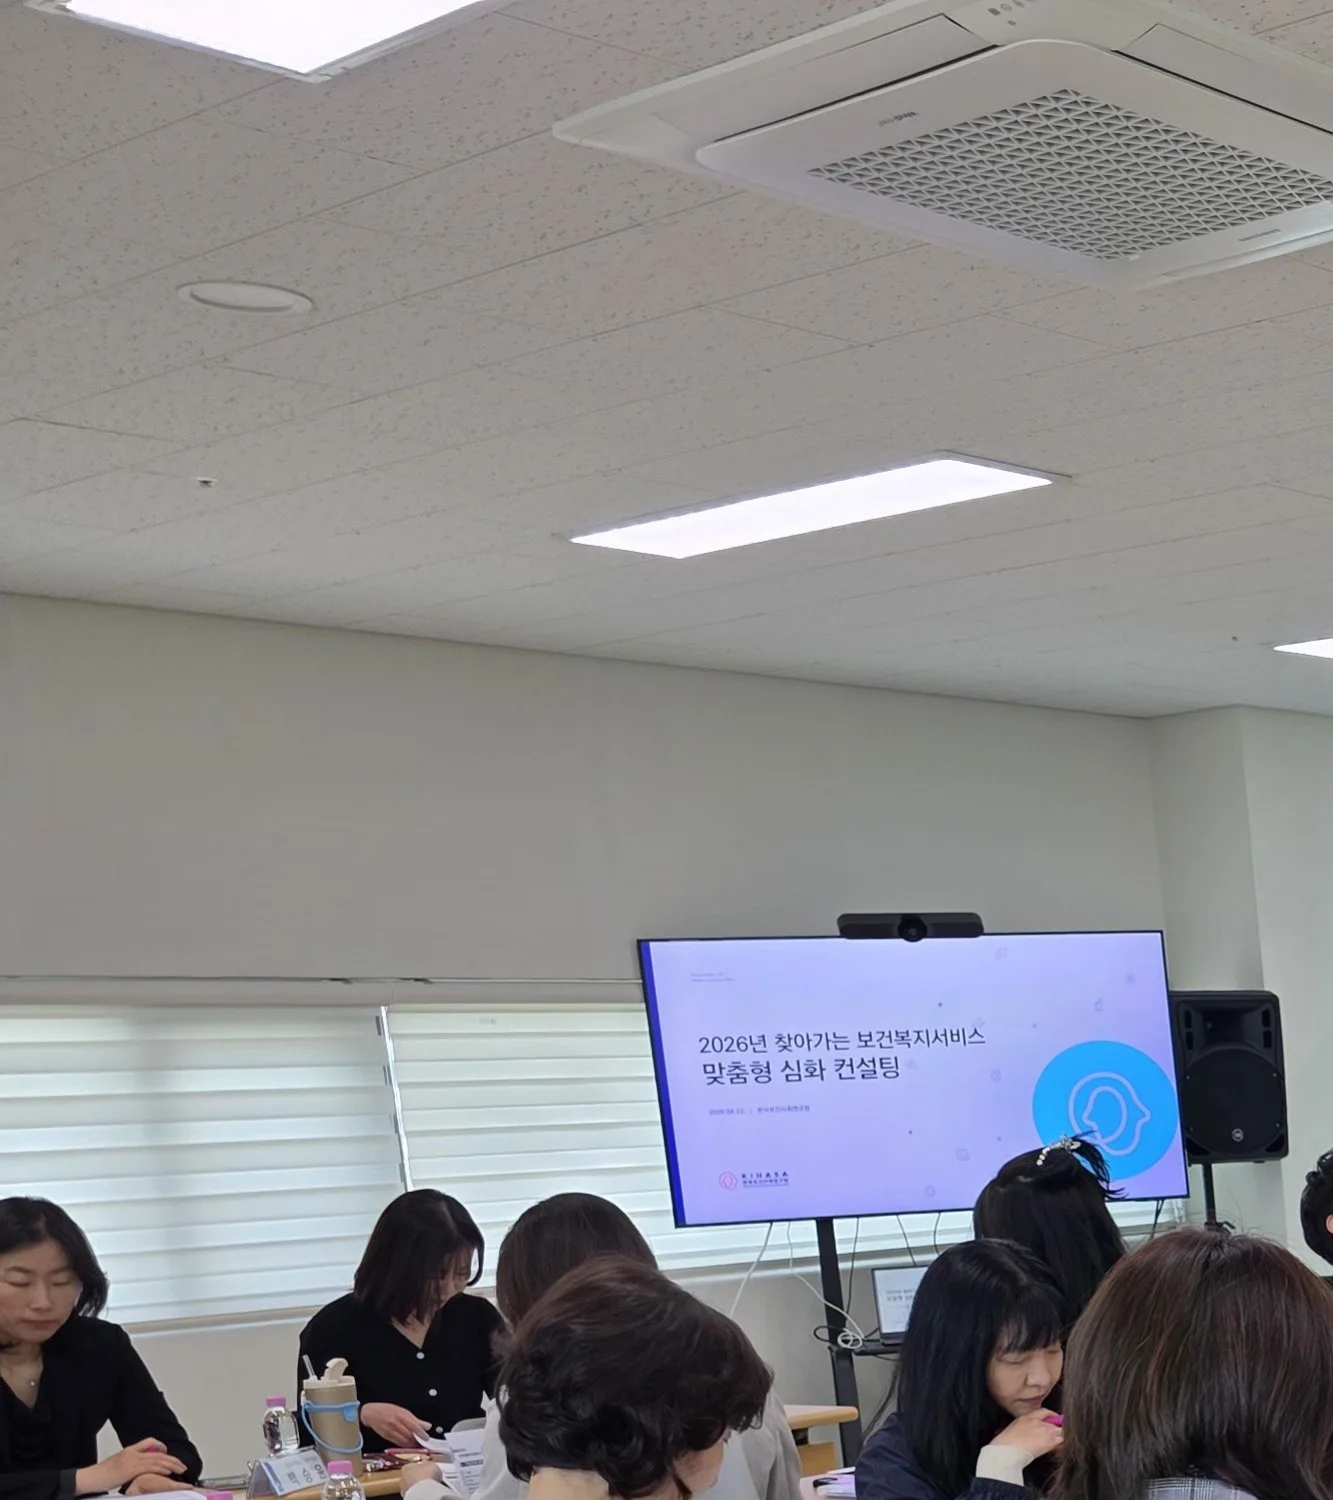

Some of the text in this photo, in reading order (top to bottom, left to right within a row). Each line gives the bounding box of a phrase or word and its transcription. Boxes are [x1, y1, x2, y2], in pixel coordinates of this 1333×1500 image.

[699, 1025, 986, 1054] 2026년 찾아가는 보건복지서비스
[702, 1054, 901, 1086] 맞춤형 심화 컨설팅
